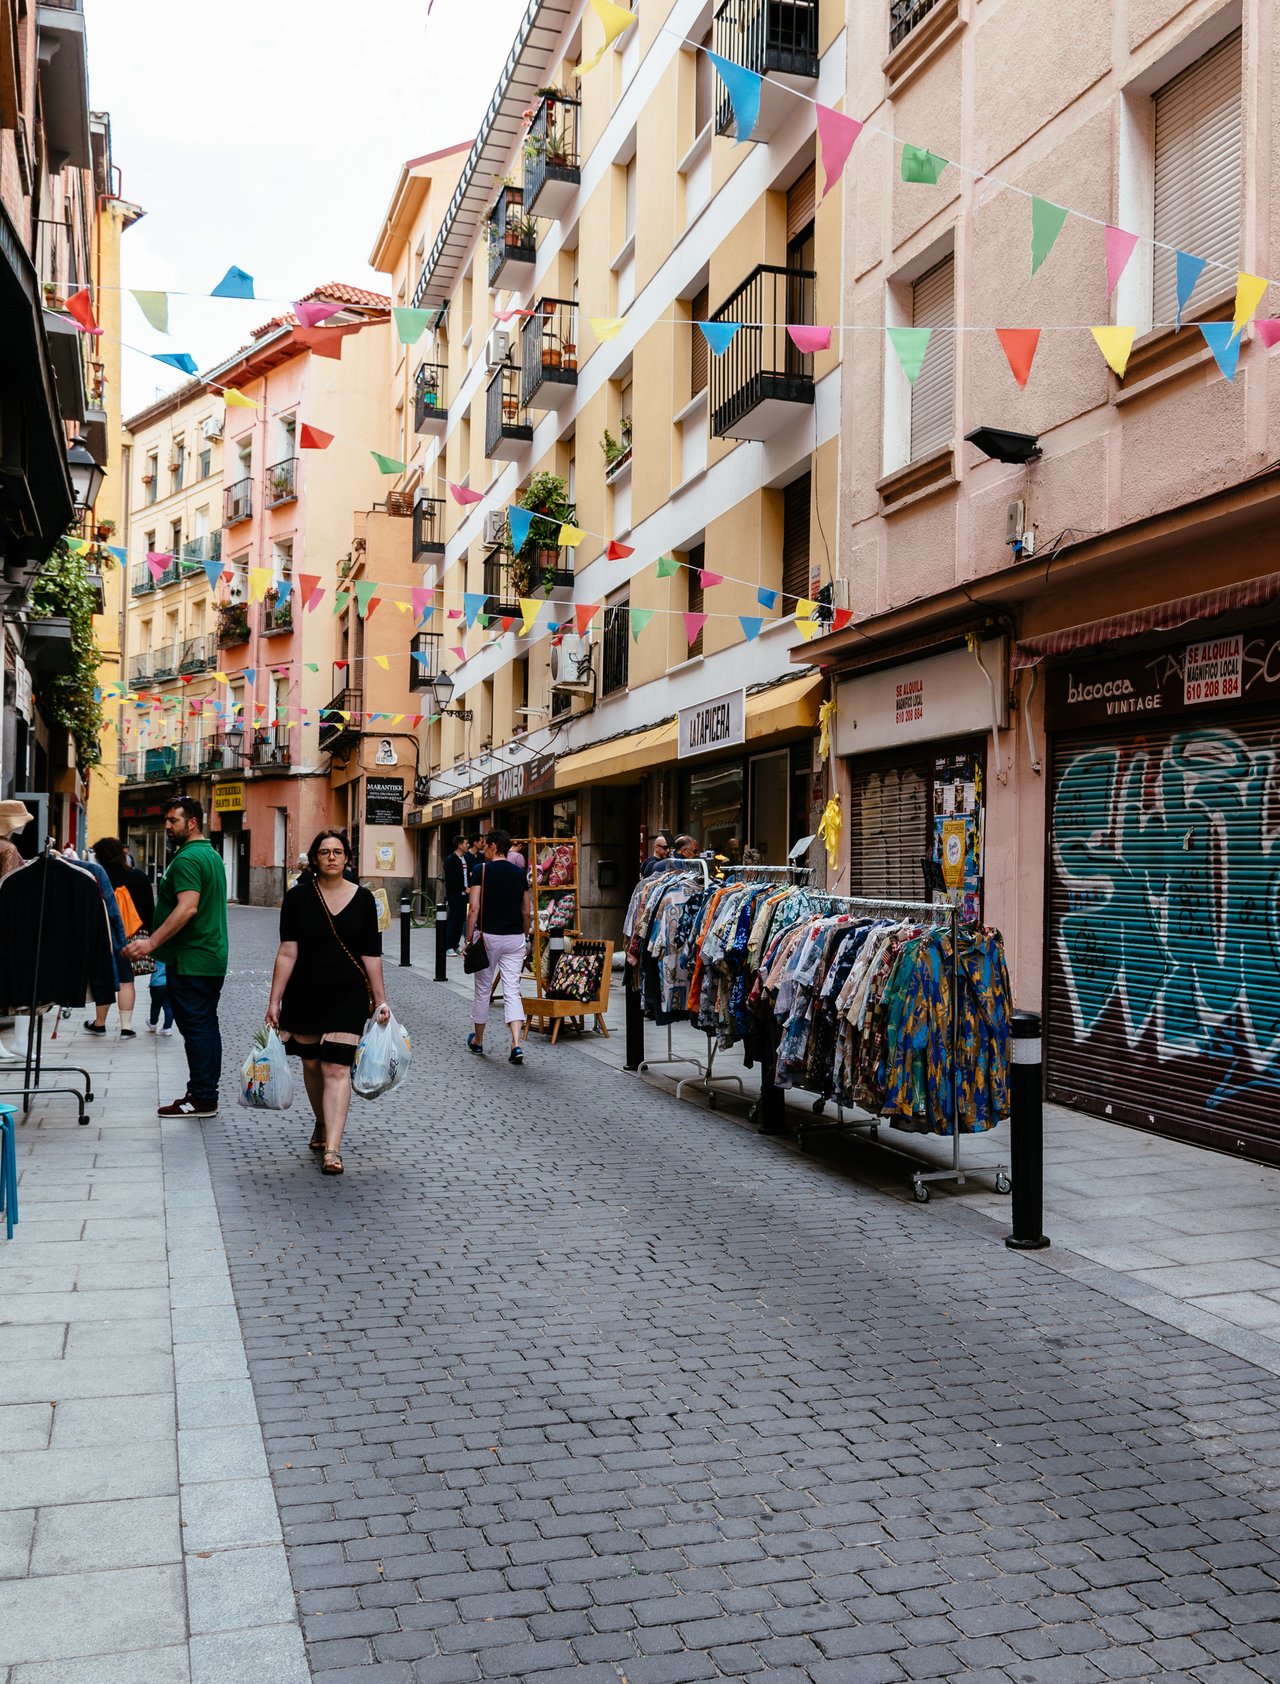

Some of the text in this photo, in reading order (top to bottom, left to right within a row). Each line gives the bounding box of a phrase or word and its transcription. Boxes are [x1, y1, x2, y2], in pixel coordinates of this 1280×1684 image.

[1188, 639, 1240, 665] SE ALQUILA
[1220, 659, 1239, 678] LOCAL
[1067, 672, 1135, 703] bicocca
[1186, 677, 1238, 701] 610 208 884
[1106, 694, 1162, 715] VINTAGE
[366, 783, 403, 791] MARANTIKK
[498, 764, 525, 801] BOXEO
